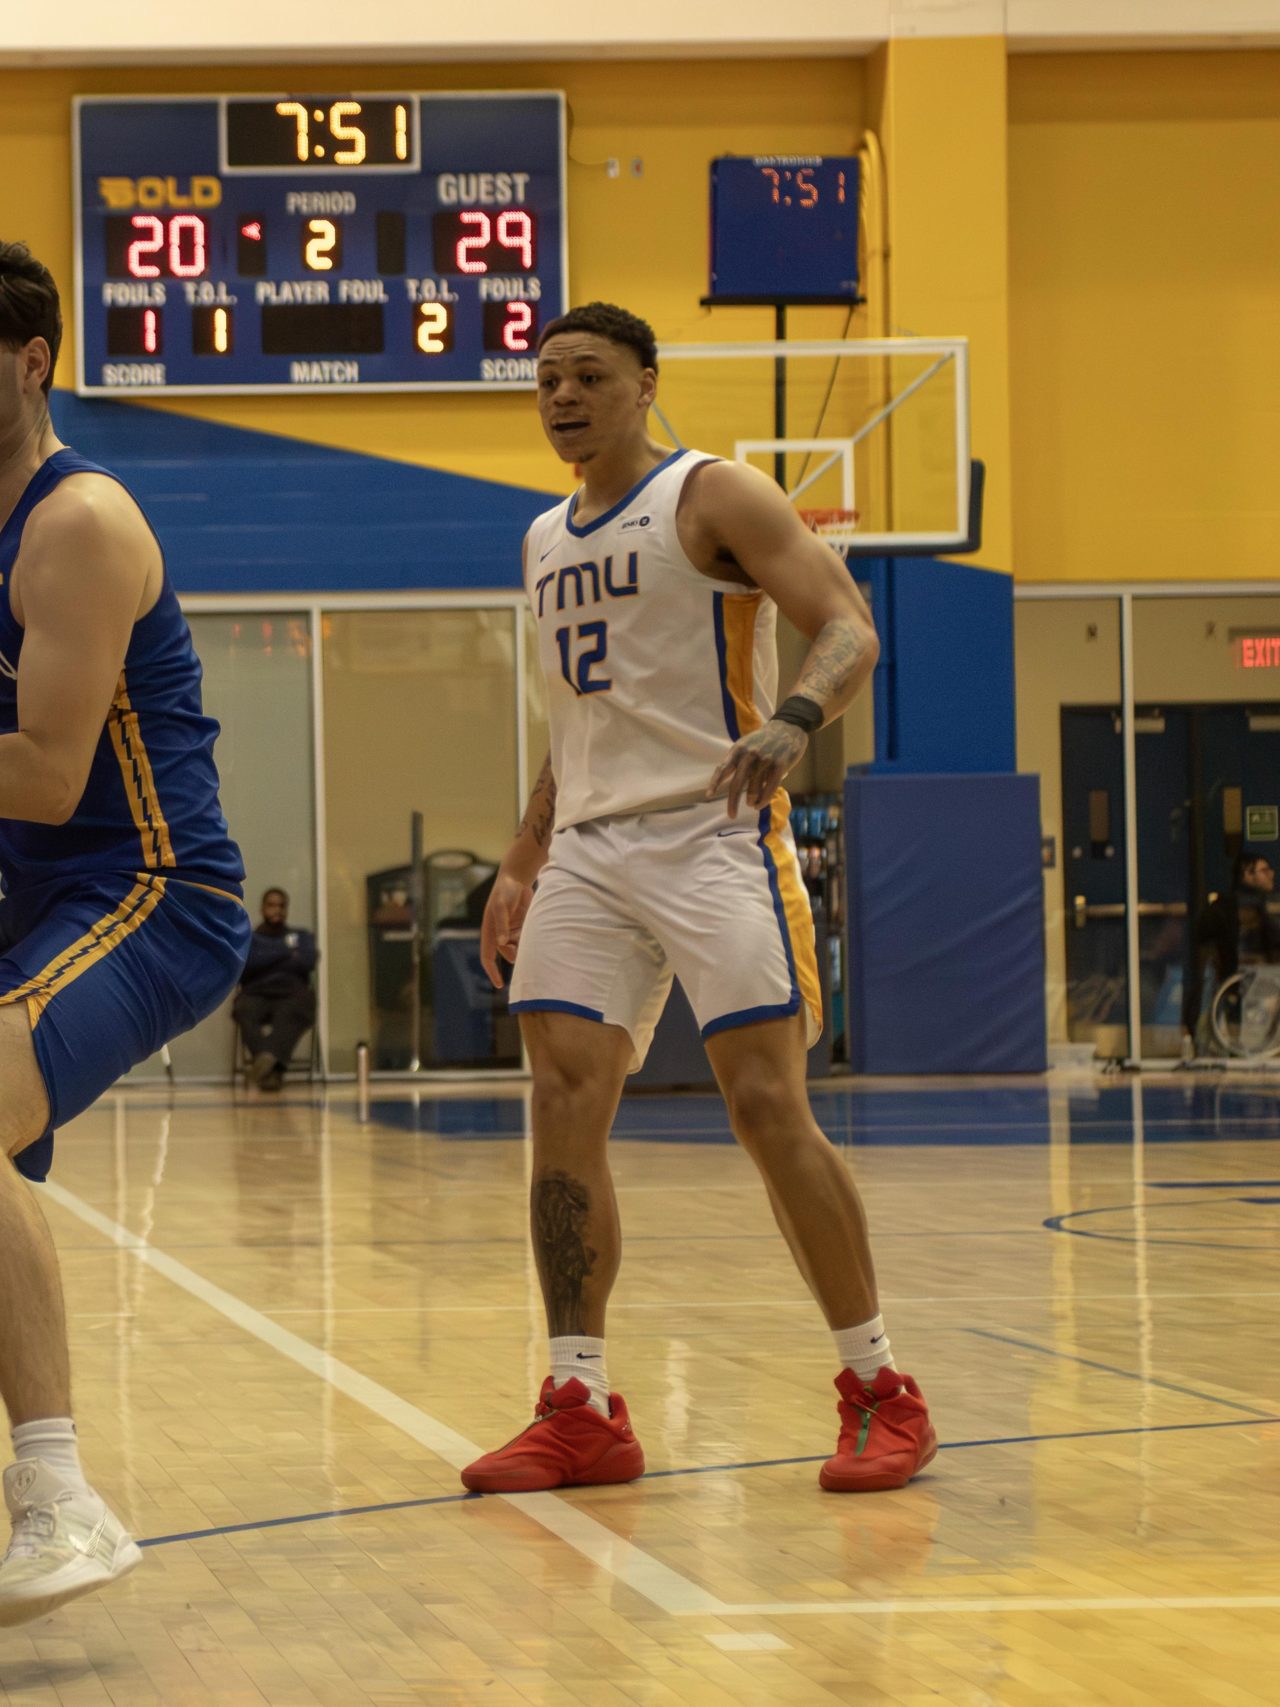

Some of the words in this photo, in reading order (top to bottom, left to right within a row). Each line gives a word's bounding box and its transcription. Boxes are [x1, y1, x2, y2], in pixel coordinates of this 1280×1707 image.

[276, 101, 407, 164] 7:51
[99, 176, 221, 208] BOLD
[286, 191, 356, 214] PERIOD
[437, 173, 531, 203] GUEST
[761, 168, 845, 208] 7:51
[128, 214, 206, 278] 20
[306, 219, 336, 270] 2
[456, 211, 532, 273] 29
[102, 281, 166, 305] FOULS
[184, 281, 238, 304] T.O.L.
[255, 280, 329, 304] PLAYER
[338, 279, 389, 303] FOUL
[405, 278, 458, 302] T.O.L.
[479, 277, 541, 300] FOULS
[144, 309, 156, 353] 1
[213, 308, 227, 353] 1
[417, 302, 447, 353] 2
[503, 302, 531, 350] 2
[102, 363, 166, 385] SCORE
[290, 361, 359, 383] MATCH
[535, 551, 639, 618] TMU
[555, 620, 612, 697] 12
[1242, 637, 1280, 668] EXIT
